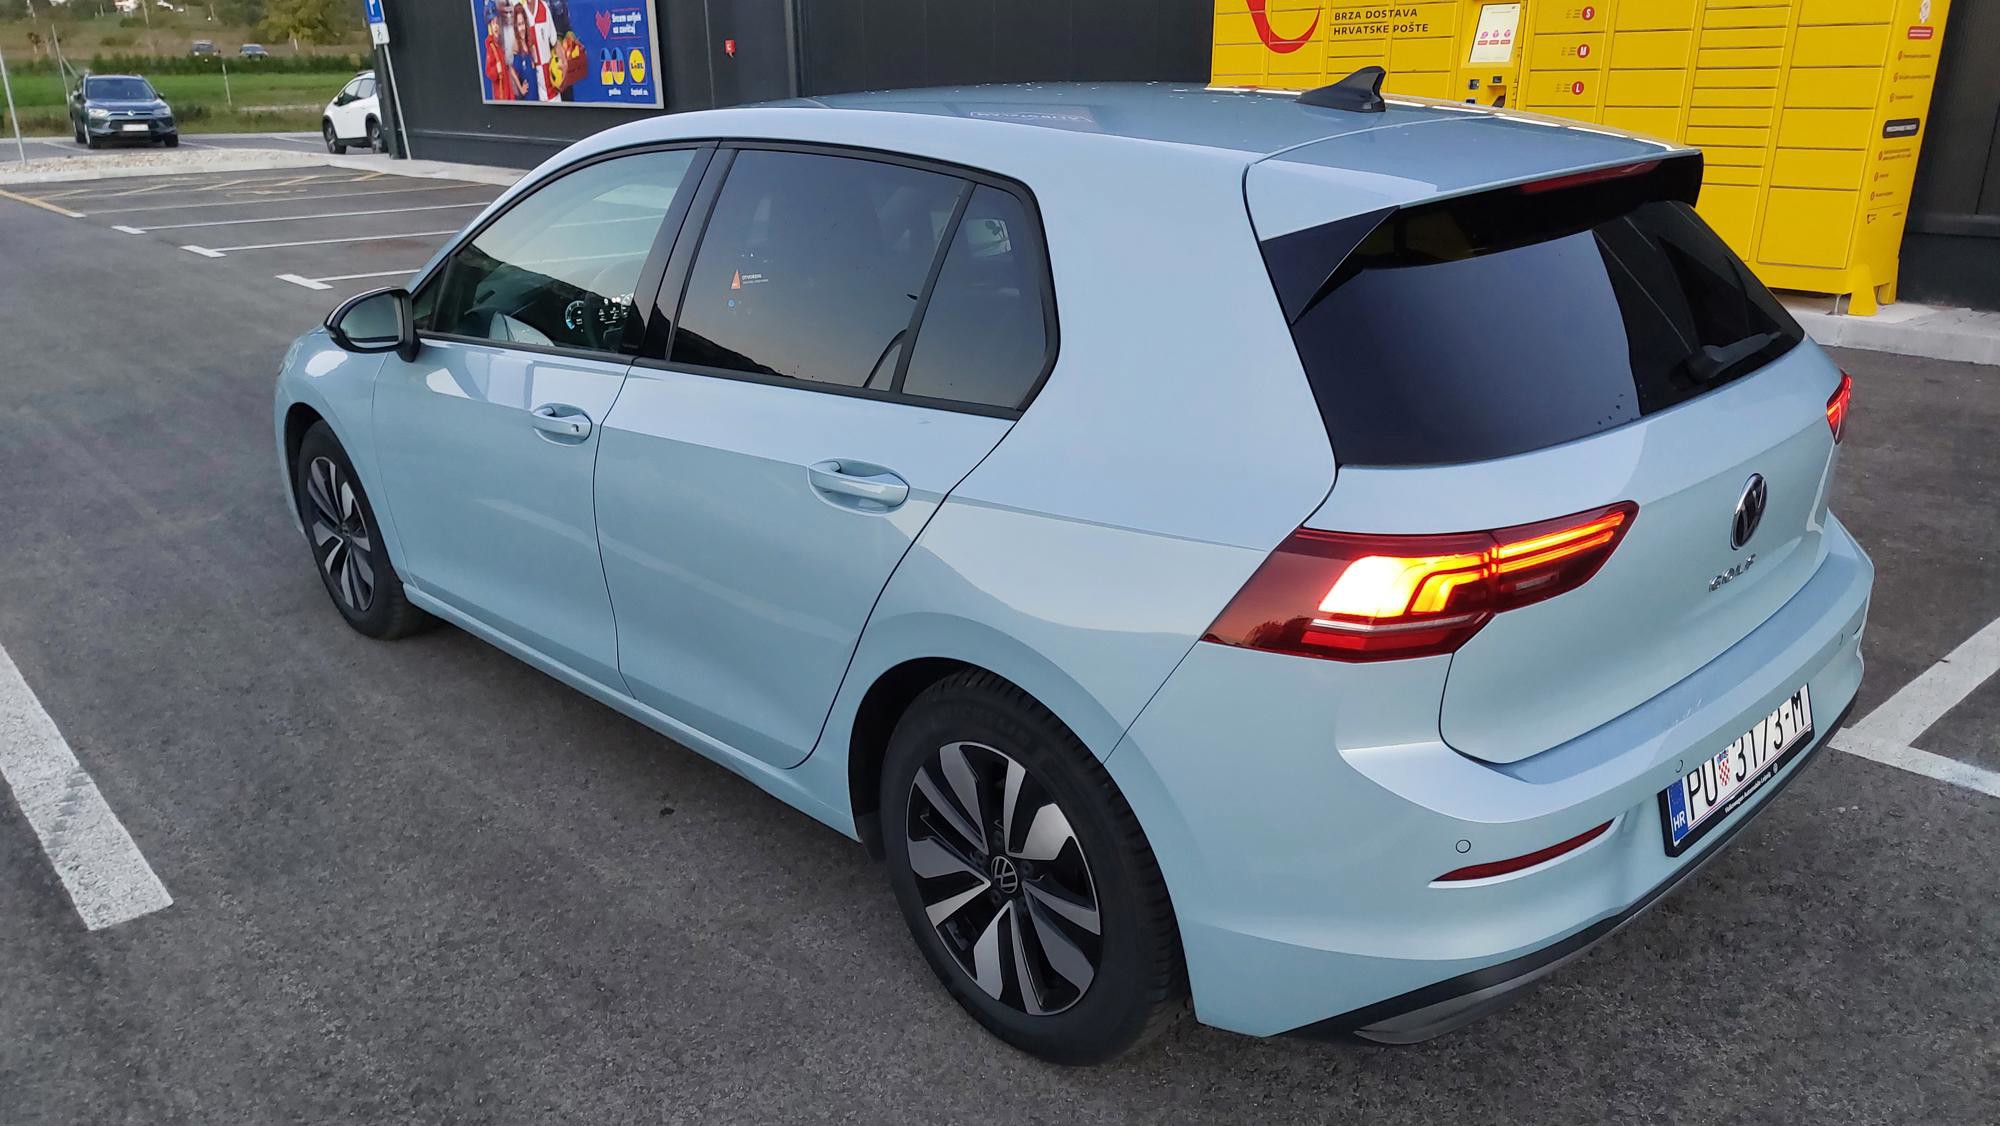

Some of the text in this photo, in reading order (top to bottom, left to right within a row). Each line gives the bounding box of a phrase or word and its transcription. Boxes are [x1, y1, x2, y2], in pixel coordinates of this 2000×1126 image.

[1334, 8, 1418, 21] BRZA DOSTAVA
[1585, 8, 1592, 19] S
[1333, 20, 1429, 36] HRVATSKE POŠTE
[1580, 46, 1587, 56] M
[600, 47, 625, 85] 20
[630, 60, 644, 69] LIDL
[1575, 83, 1580, 93] L
[1709, 553, 1756, 592] GOLF
[1686, 690, 1805, 822] PU 3173-M
[1673, 809, 1687, 832] HR
